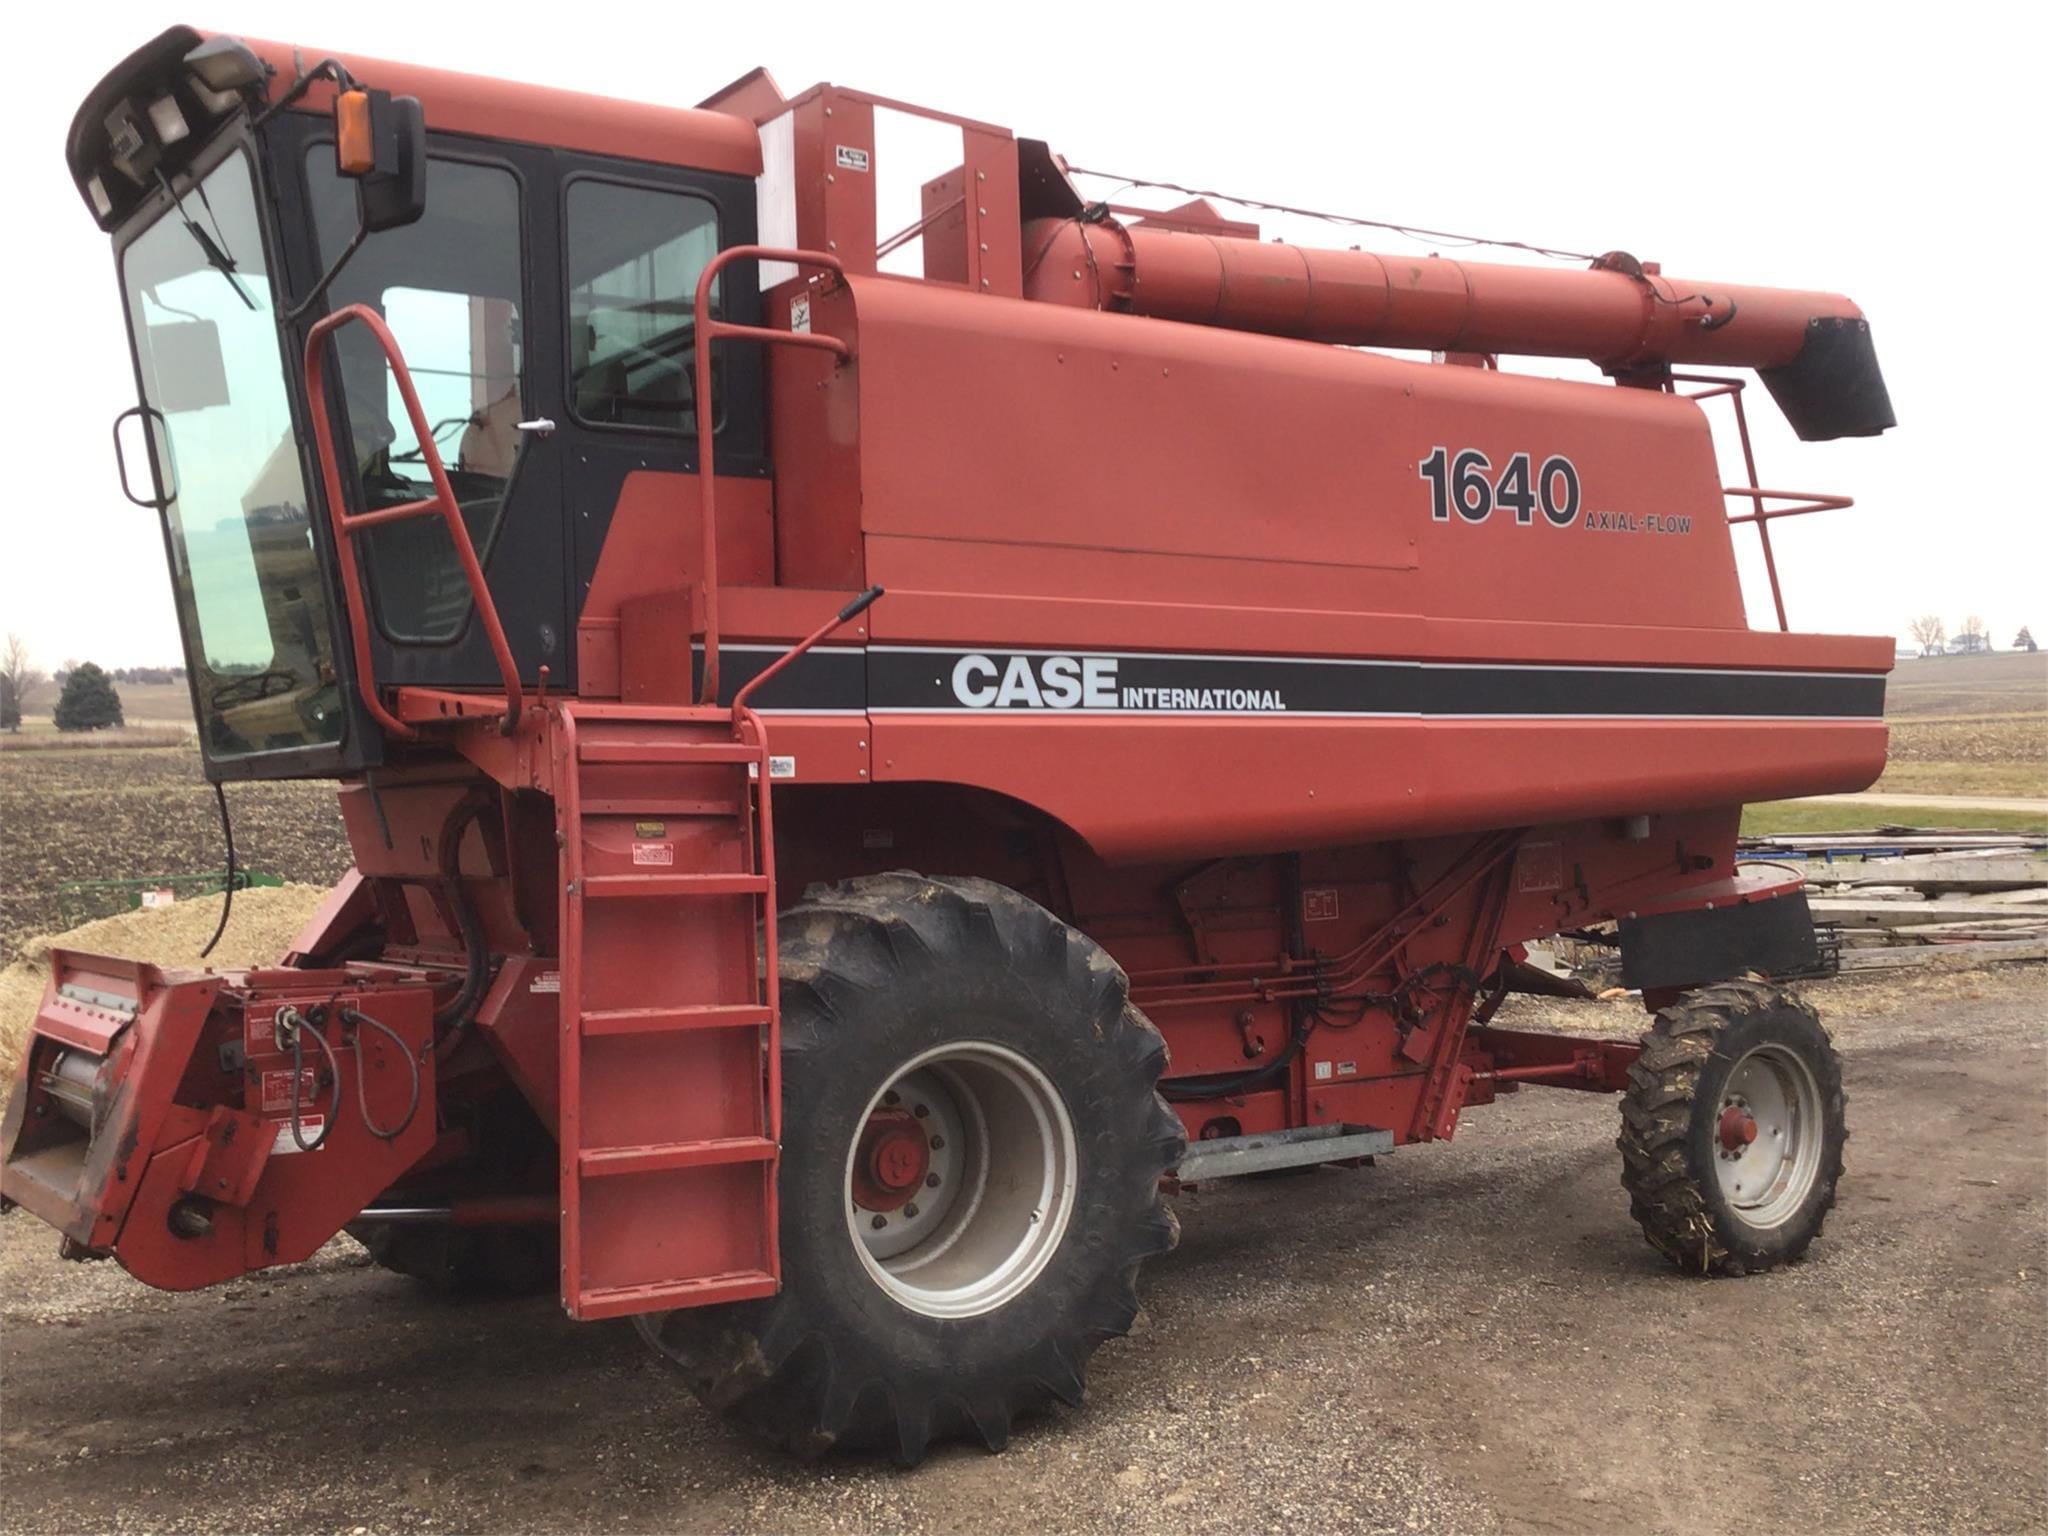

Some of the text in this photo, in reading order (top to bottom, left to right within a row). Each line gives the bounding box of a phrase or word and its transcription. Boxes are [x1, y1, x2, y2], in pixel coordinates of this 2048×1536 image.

[1419, 446, 1581, 528] 1640
[1584, 511, 1692, 535] AXIAL-FLOW
[951, 654, 1287, 711] CASE INTERNATIONAL
